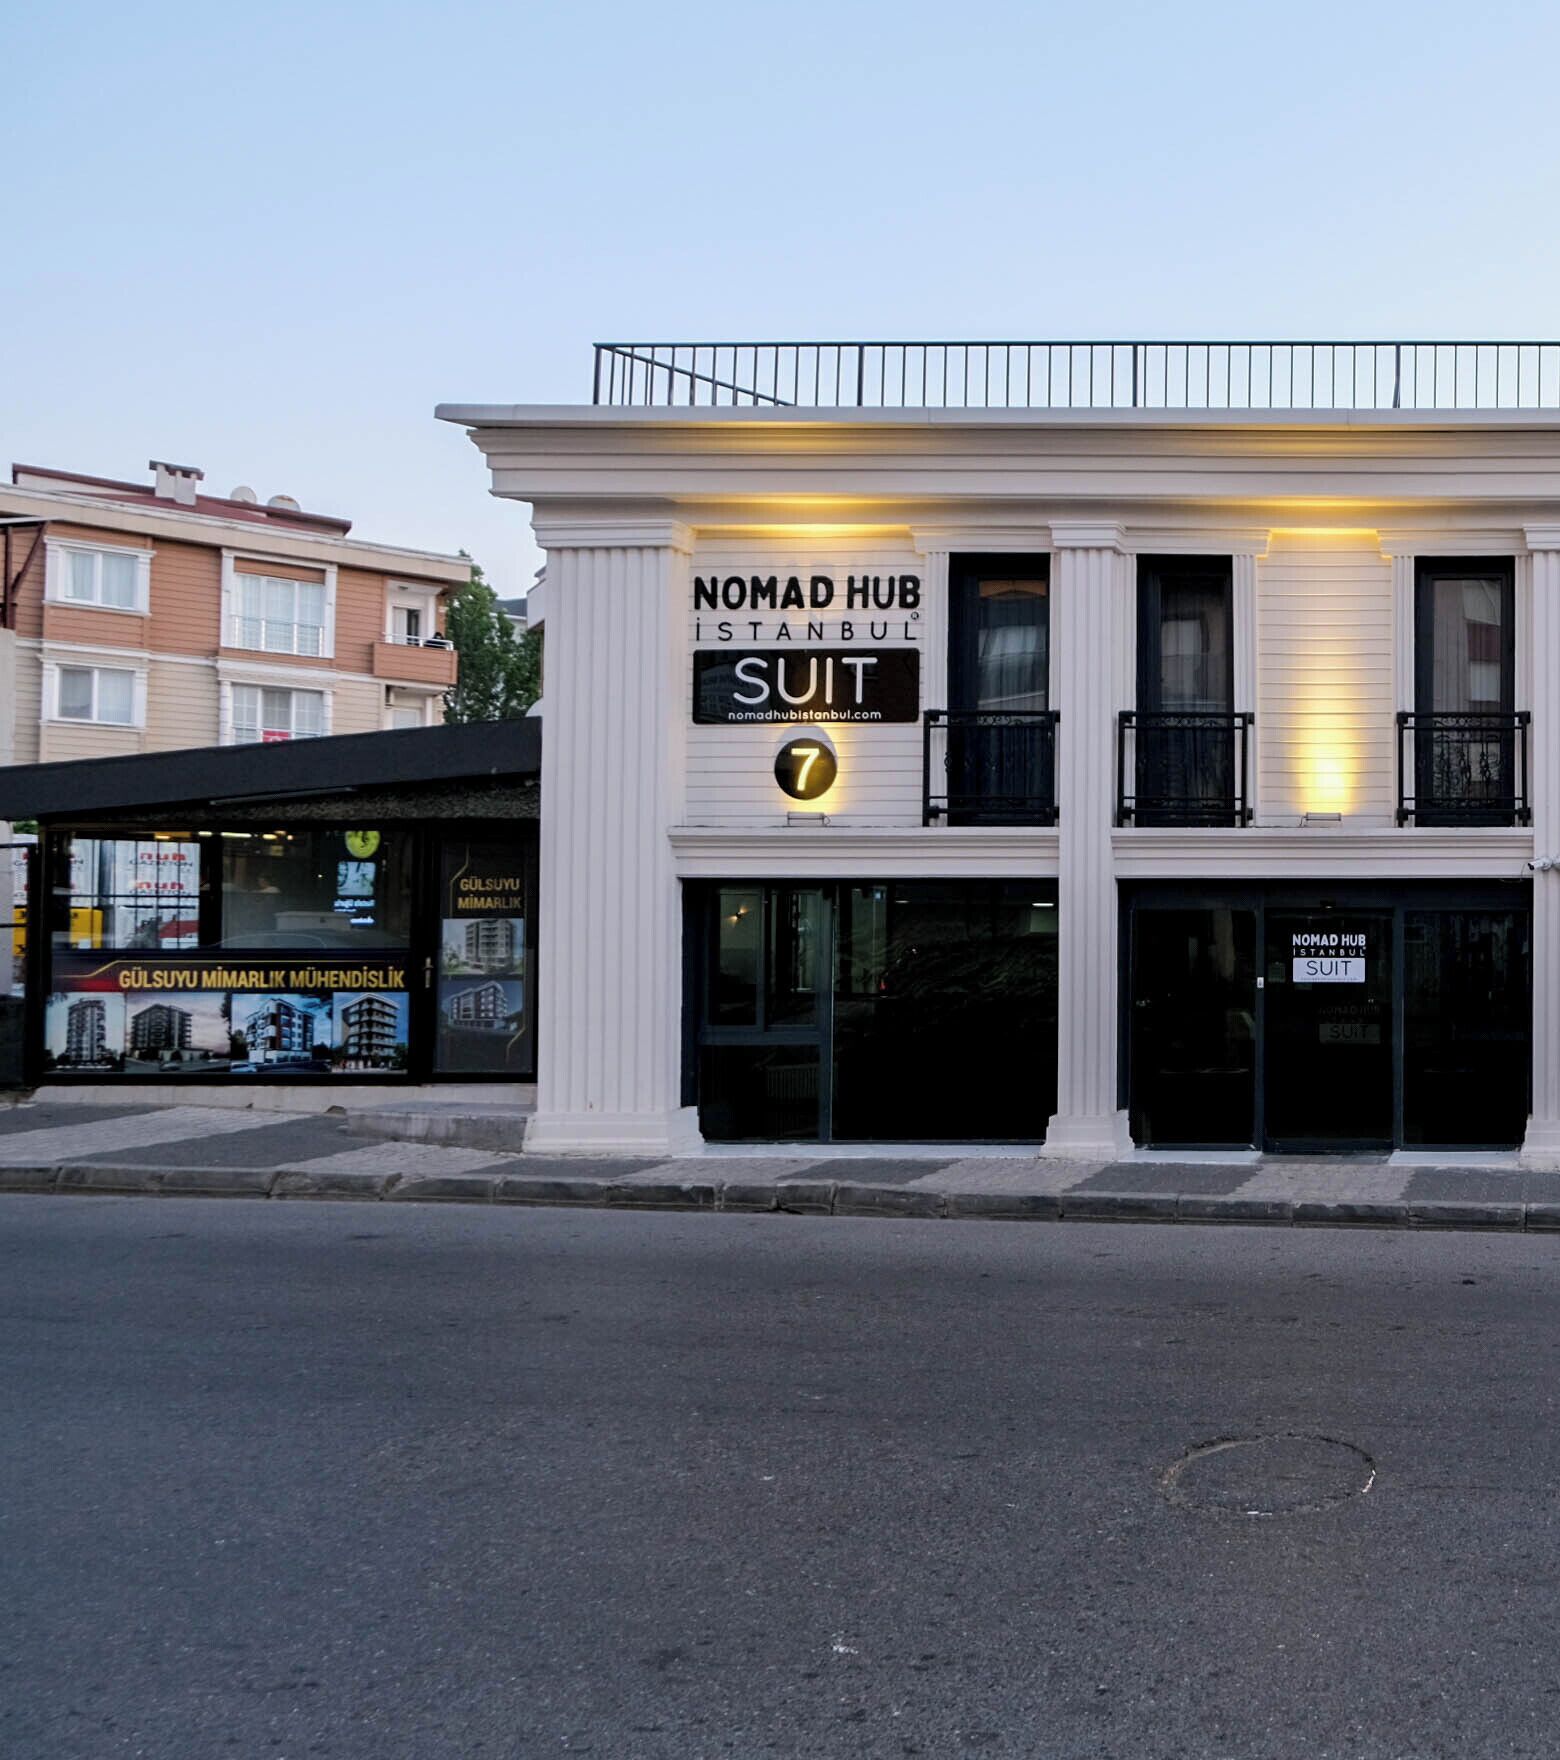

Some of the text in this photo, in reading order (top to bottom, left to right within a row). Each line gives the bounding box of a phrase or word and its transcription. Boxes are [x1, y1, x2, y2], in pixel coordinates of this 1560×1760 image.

[694, 574, 921, 610] NOMAD HUB
[695, 617, 917, 641] İSTANBUL
[733, 657, 878, 704] SUIT
[728, 709, 882, 721] nomadhubistanbul.com
[791, 748, 820, 791] 7
[460, 876, 520, 890] GÜLSUYU
[458, 894, 522, 909] MİMARLIK
[1293, 934, 1366, 946] NOMAD HUB
[119, 966, 404, 988] GÜLSUYU MİMARLIK MÜHENDİSLİK
[1306, 960, 1352, 976] SUIT
